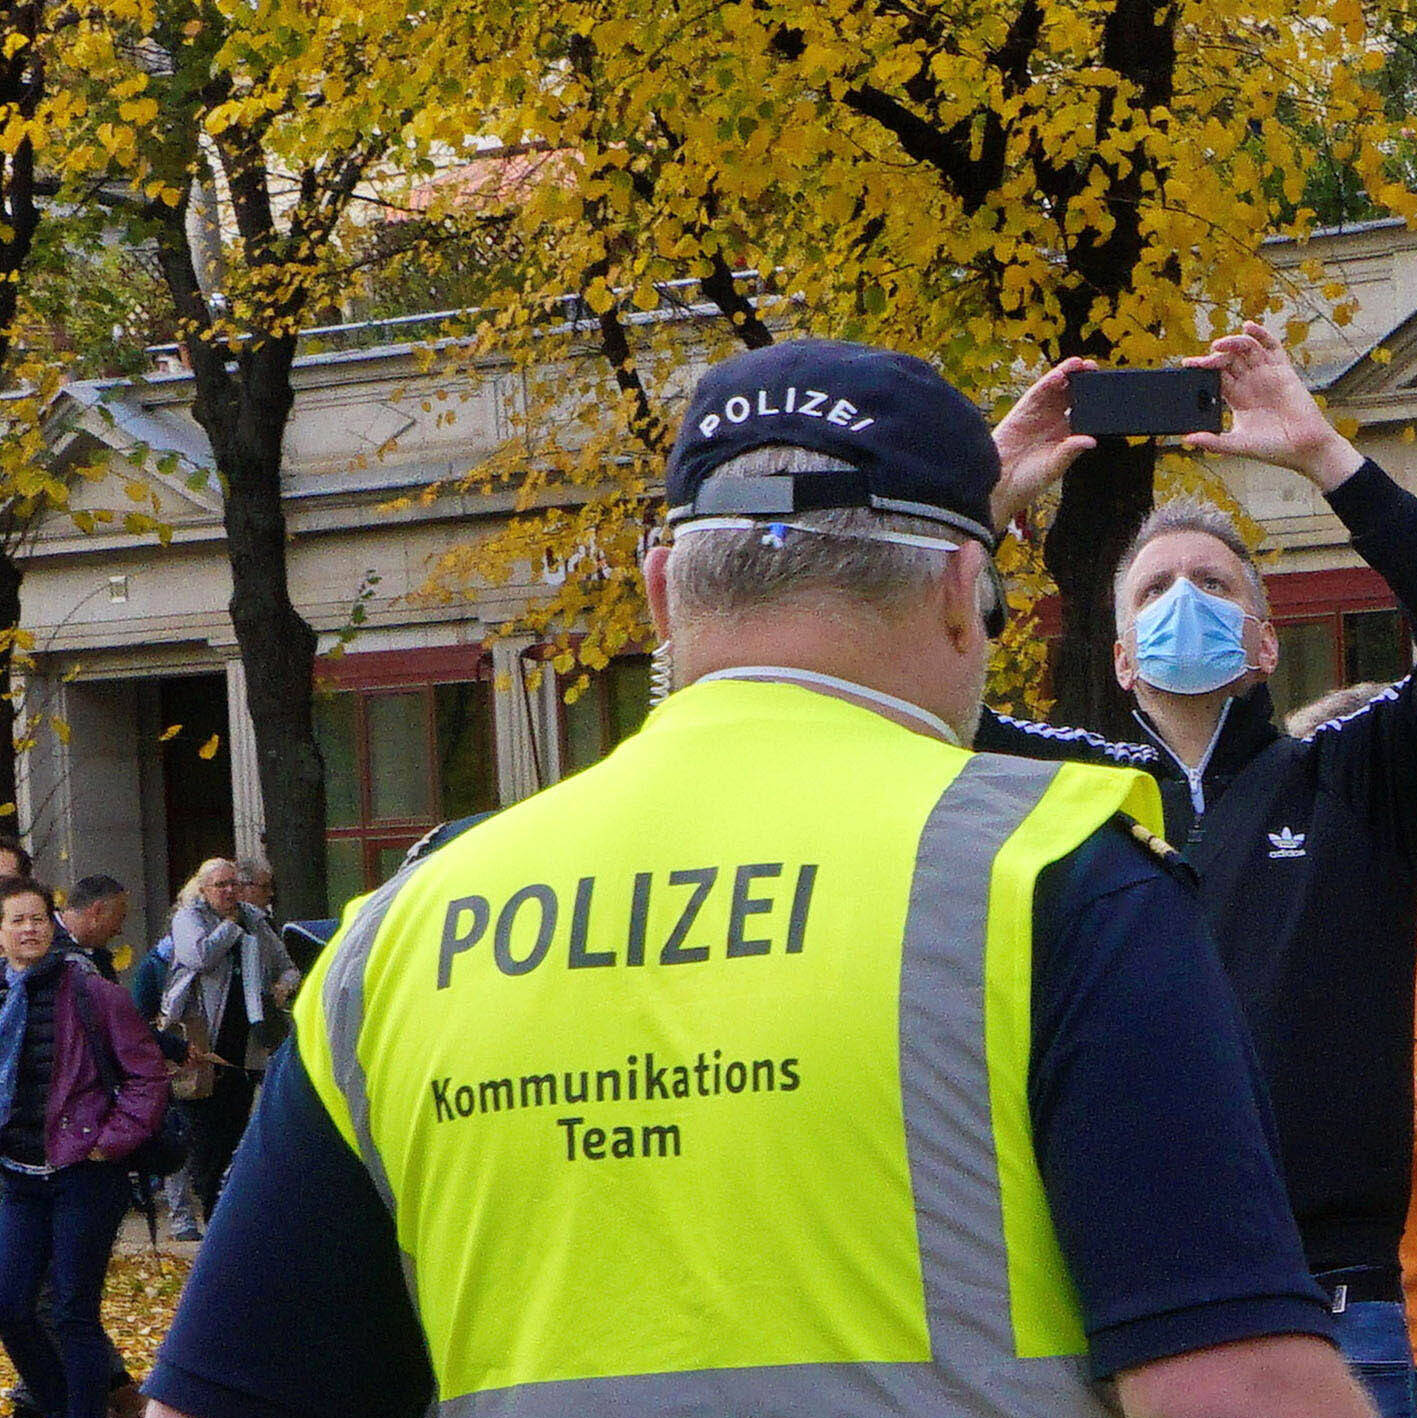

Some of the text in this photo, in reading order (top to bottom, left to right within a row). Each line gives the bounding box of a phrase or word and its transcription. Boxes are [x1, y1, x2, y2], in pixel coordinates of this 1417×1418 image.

[699, 387, 875, 438] POLIZEI
[437, 863, 818, 990] POLIZEI
[431, 1050, 800, 1123] Kommunikations
[557, 1117, 681, 1161] Team
